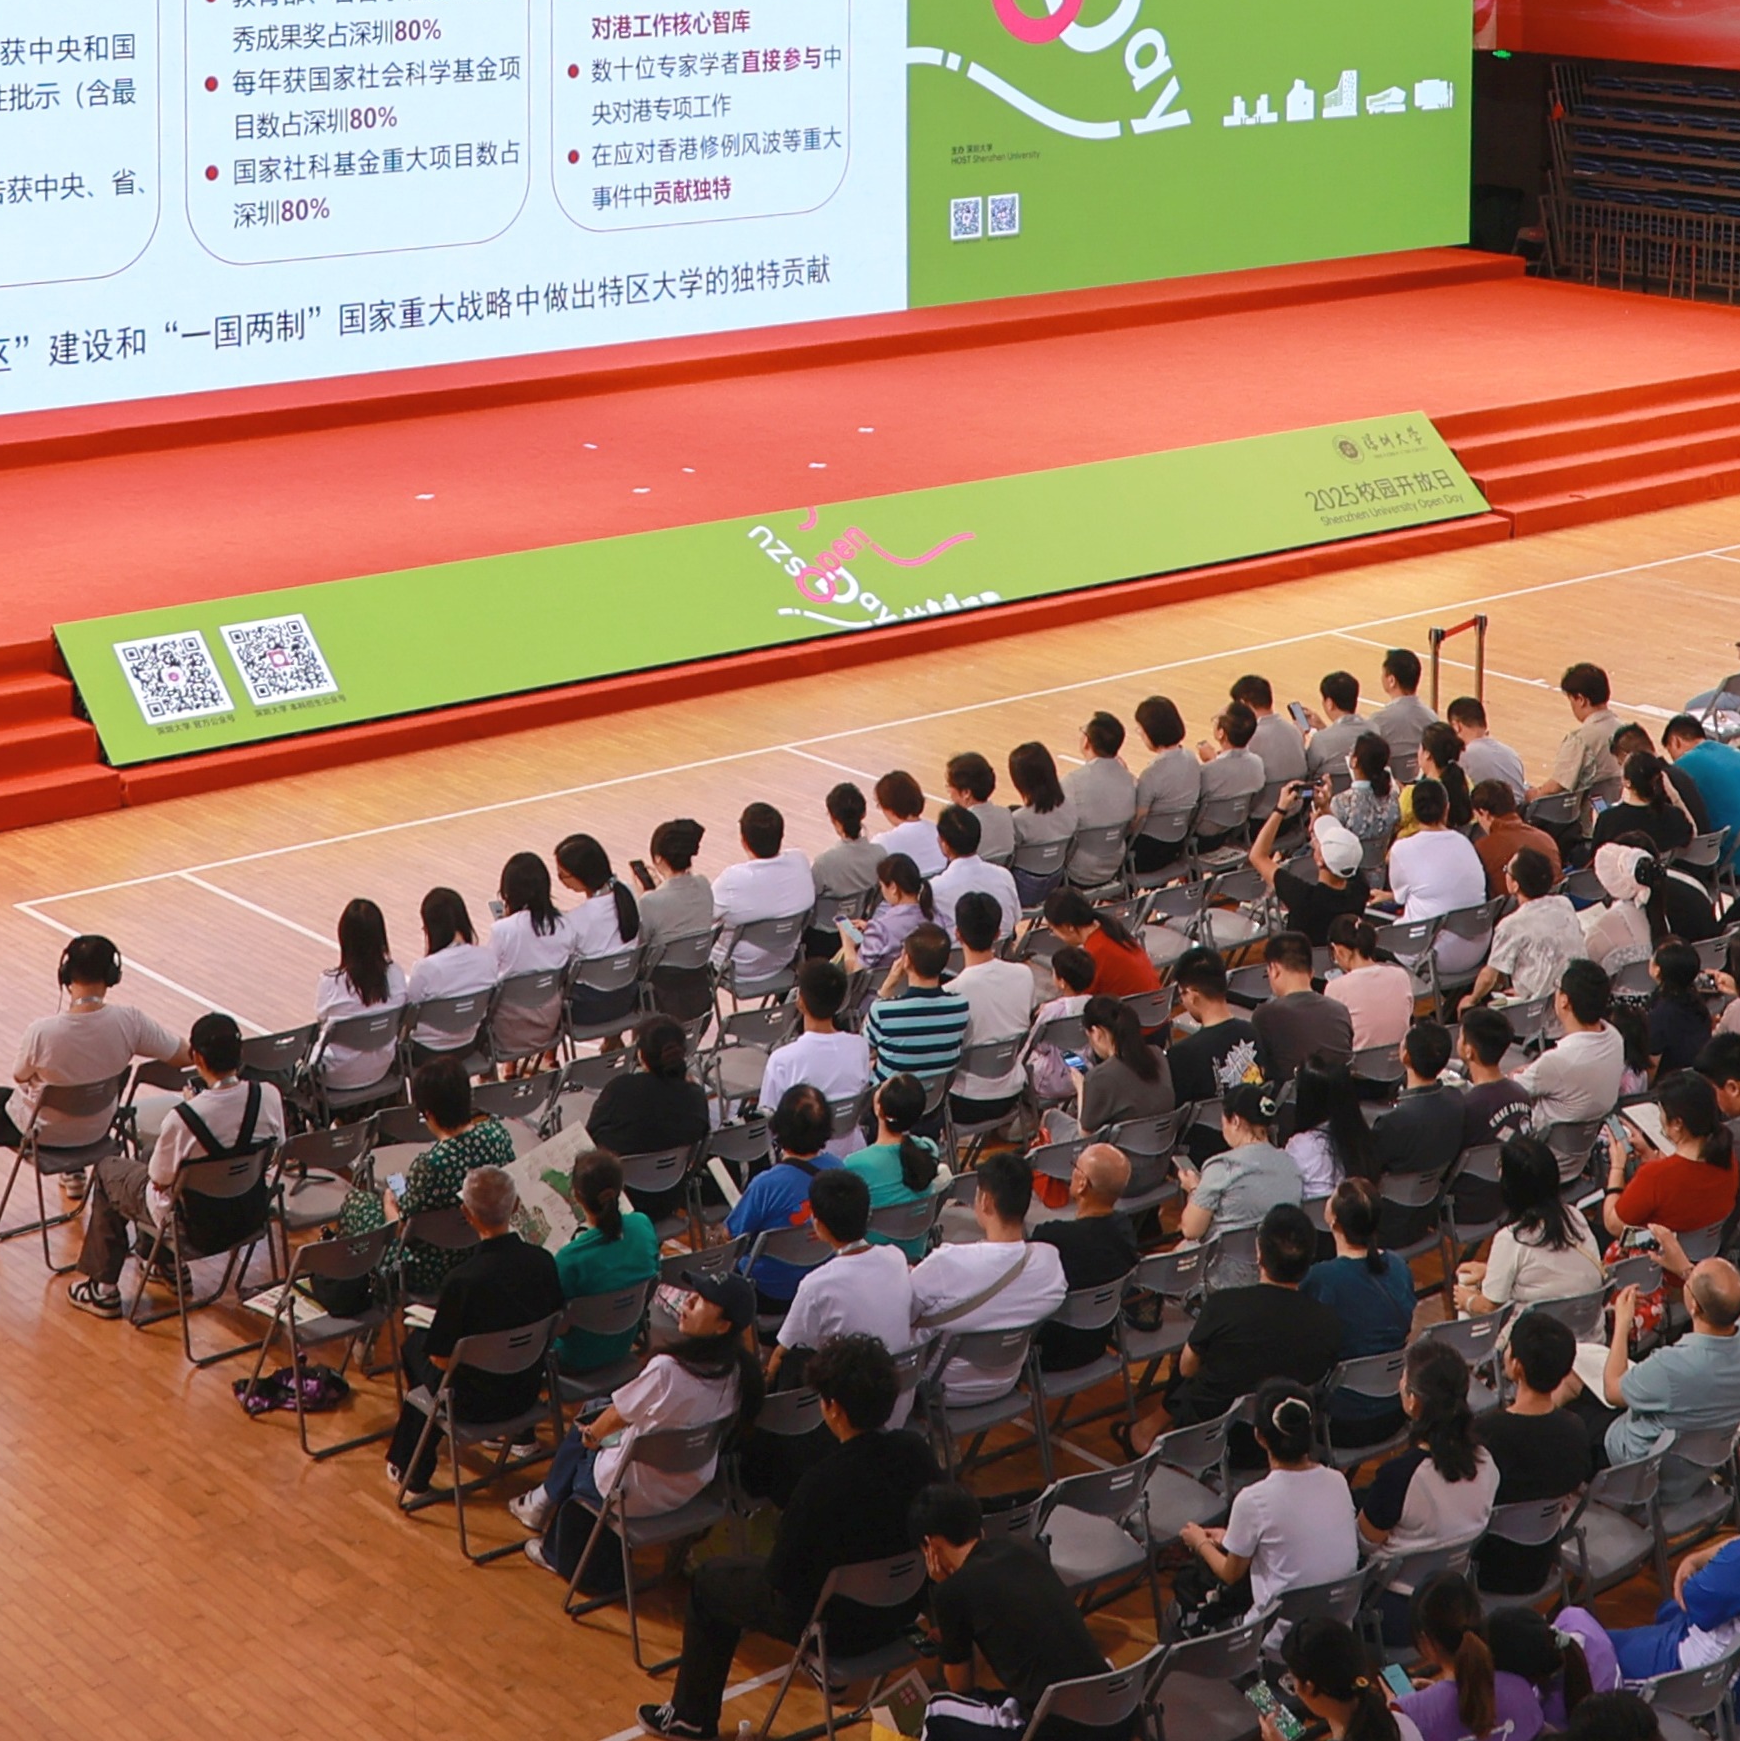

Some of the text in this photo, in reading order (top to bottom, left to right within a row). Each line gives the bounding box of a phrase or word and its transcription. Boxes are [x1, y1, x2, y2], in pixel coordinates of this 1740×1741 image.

[231, 18, 443, 54] 秀成果奖占深圳80%
[591, 8, 751, 40] 对港工作核心智库
[232, 55, 521, 98] 每年获国家社会科学基金项
[590, 45, 843, 83] 数十位专家学者直接参与中
[234, 106, 398, 141] 目数占深圳80%
[591, 92, 732, 125] 央对港专项工作
[233, 141, 521, 186] 国家社科基金重大项目数占
[591, 125, 843, 168] 在应对香港修例风波等重大
[591, 177, 732, 211] 事件中贡献独特
[232, 197, 331, 230] 深圳80%
[1304, 468, 1456, 512] 2025校园开放日
[1320, 506, 1371, 527] Shenzhen
